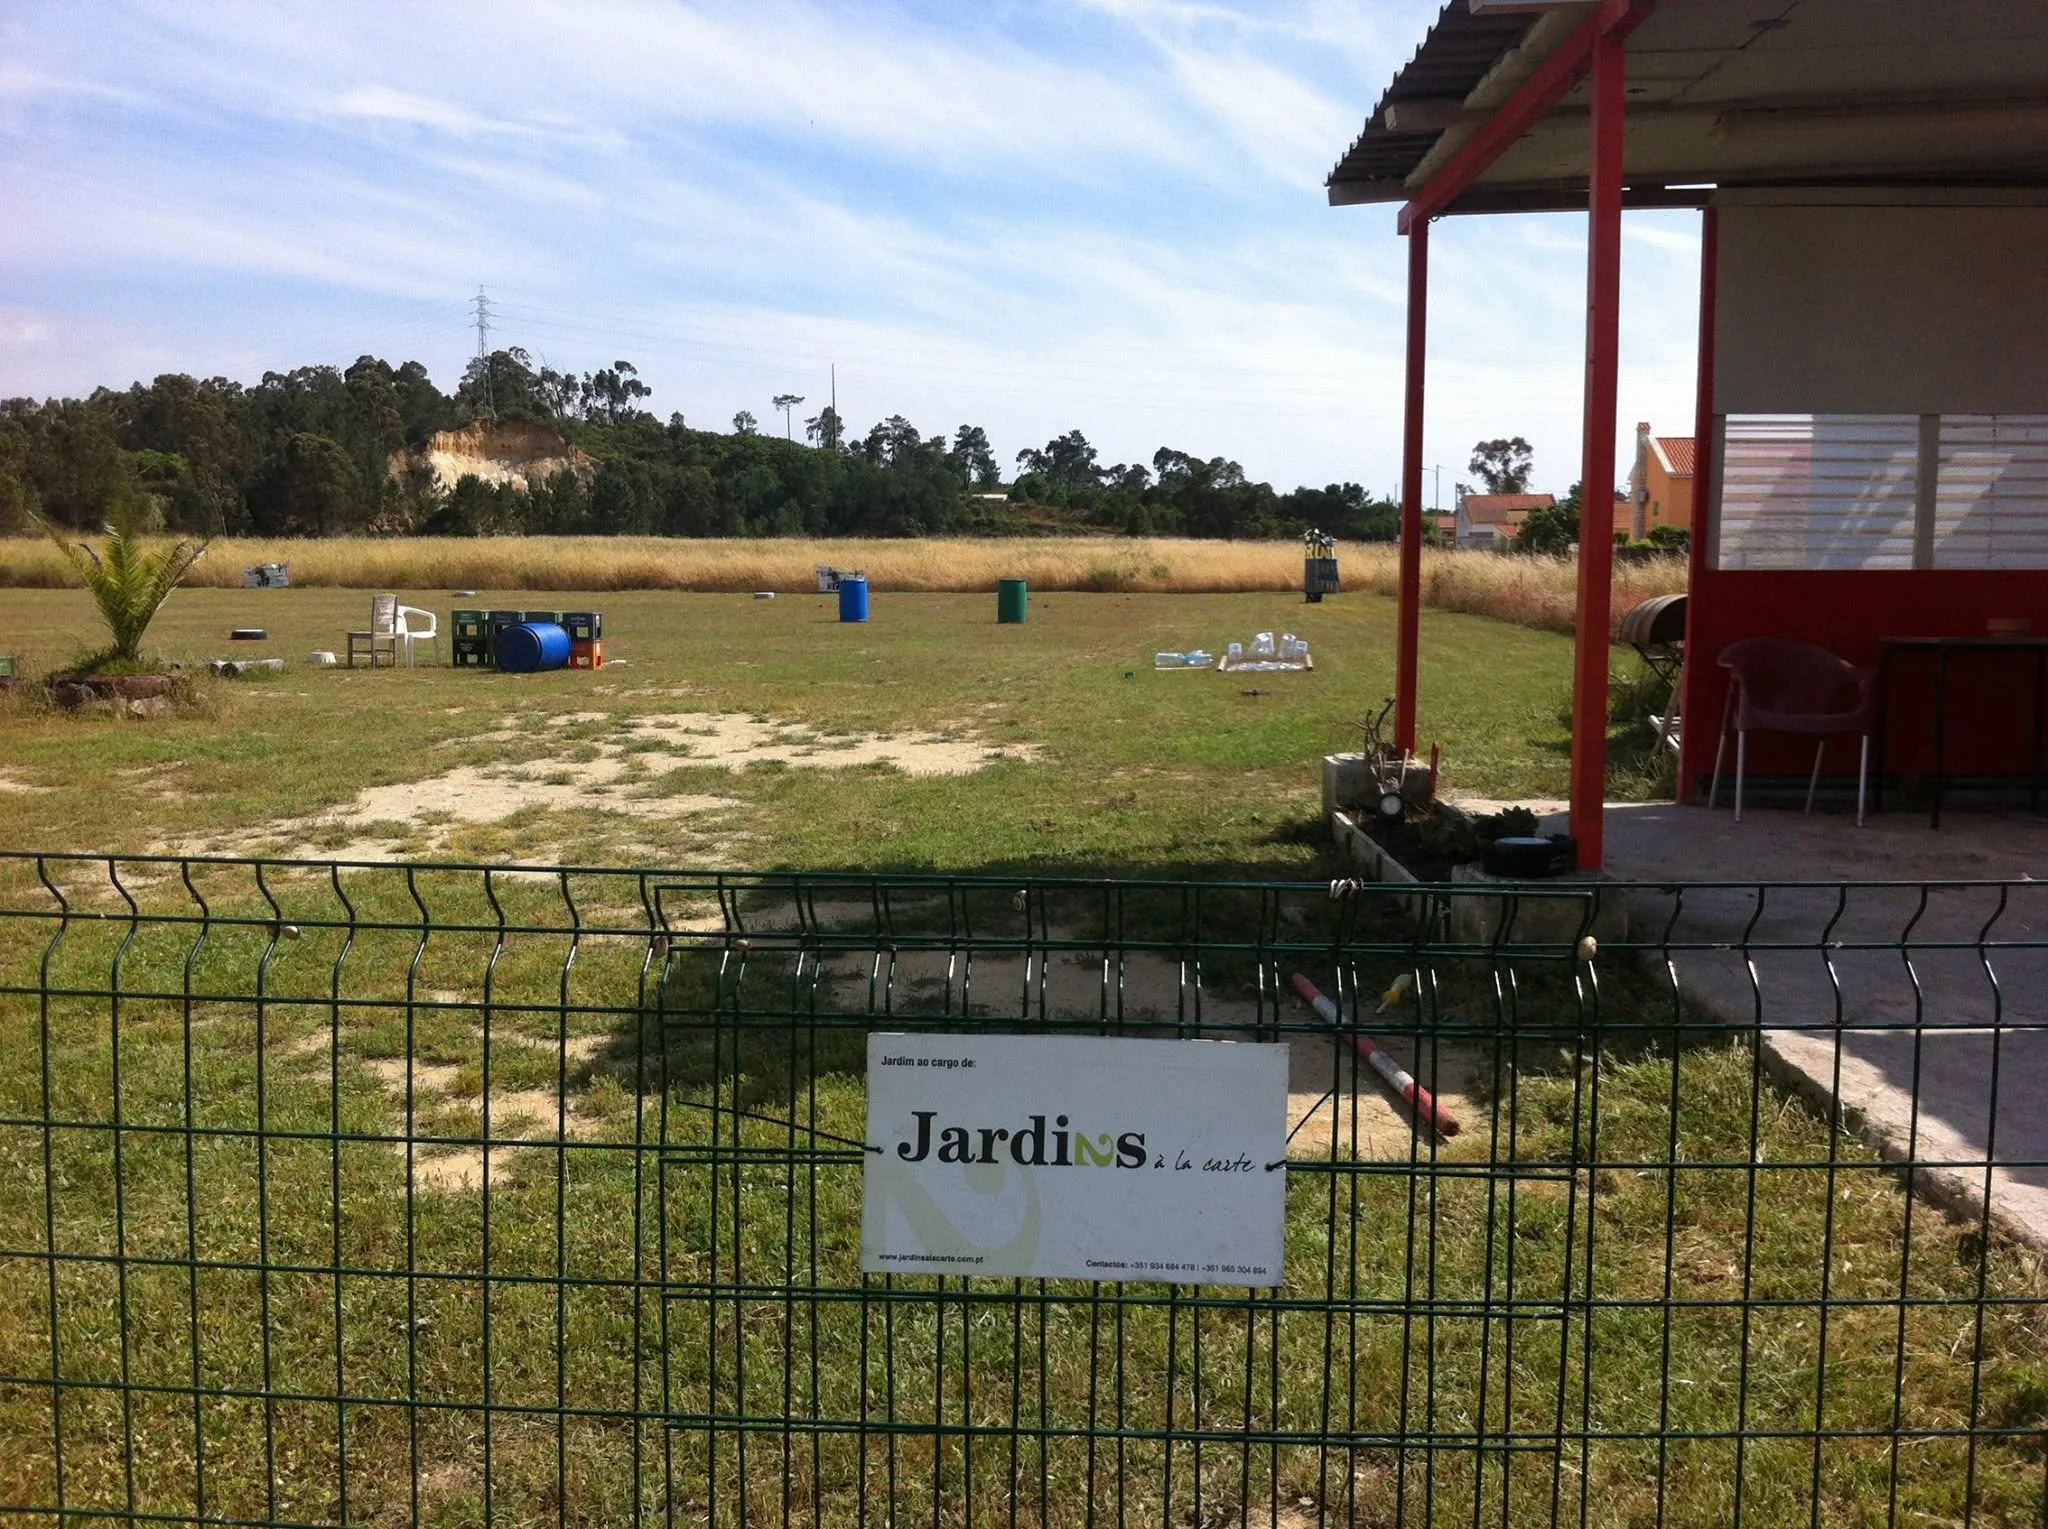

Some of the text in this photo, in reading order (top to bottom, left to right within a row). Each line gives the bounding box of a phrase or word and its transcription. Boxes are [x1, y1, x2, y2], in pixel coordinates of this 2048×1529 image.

[881, 1056, 976, 1069] Jardim ao cargo de:
[1175, 1150, 1193, 1171] la
[1202, 1152, 1256, 1173] carte
[879, 1253, 984, 1264] www.jardinsalacarte.com.pt
[1086, 1259, 1128, 1268] Contactos:
[1130, 1261, 1148, 1269] +351
